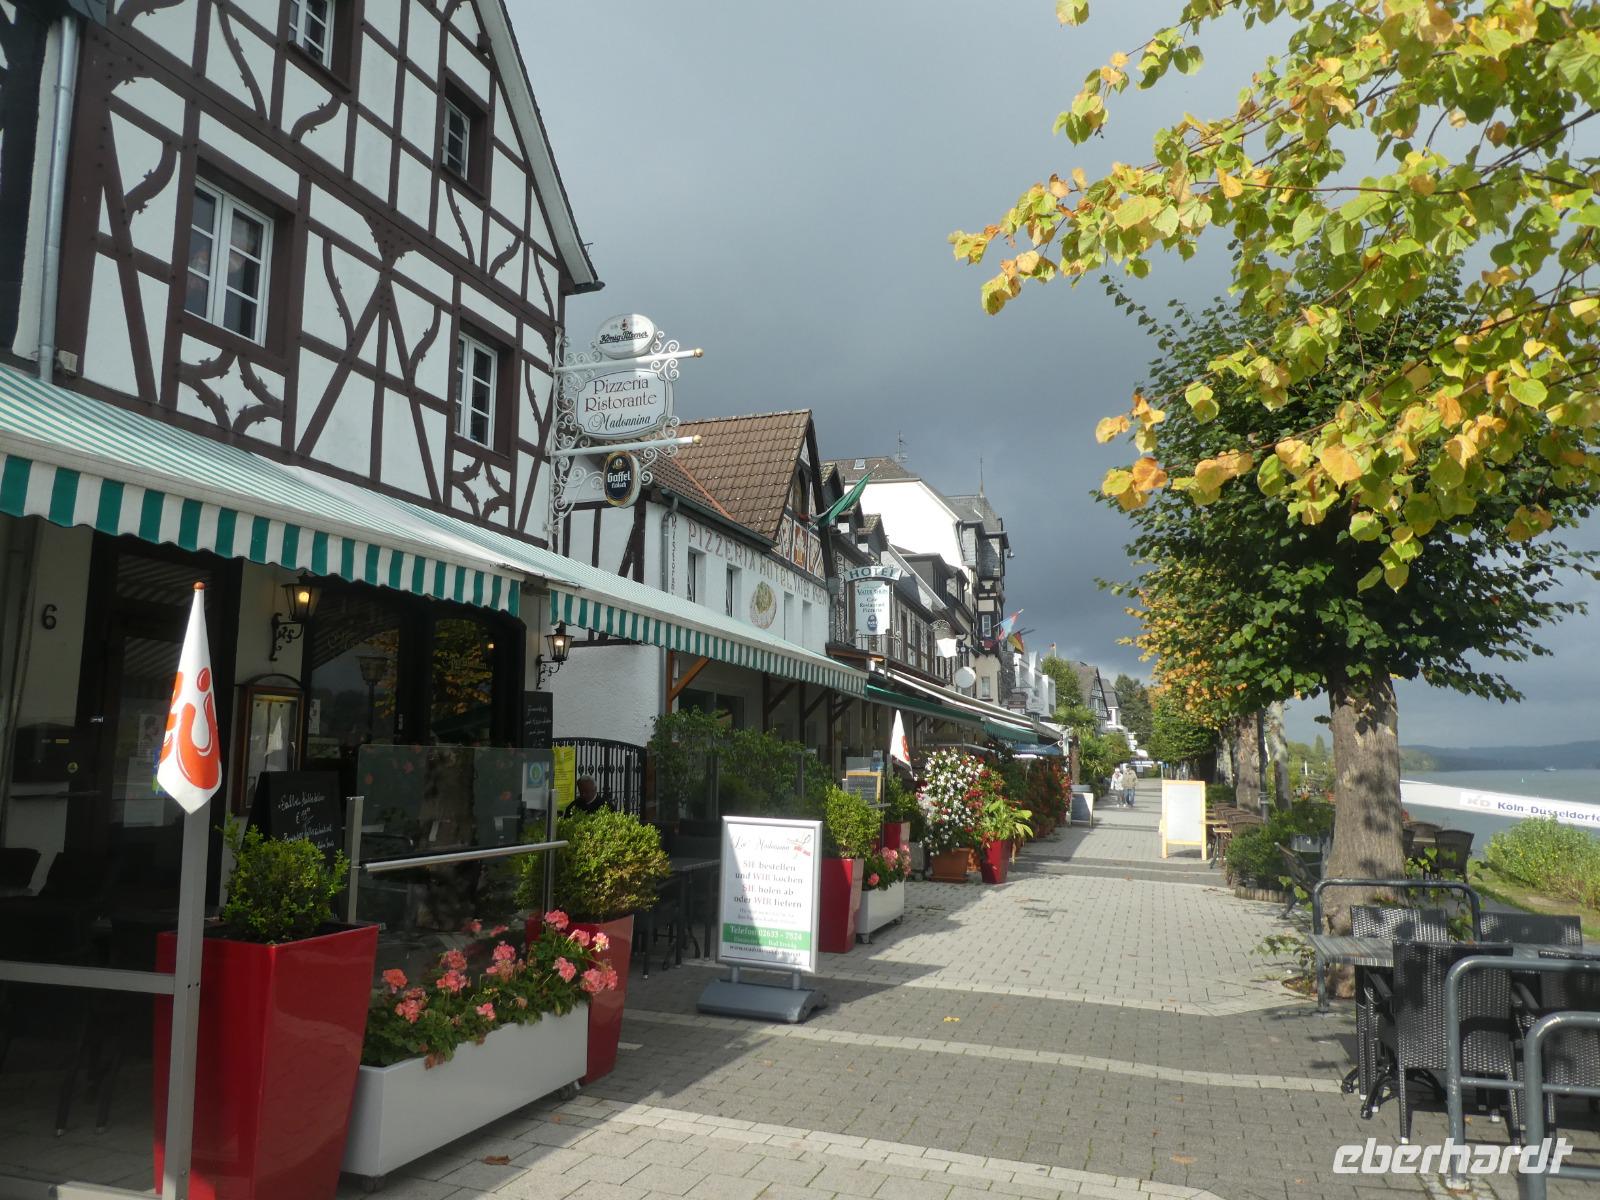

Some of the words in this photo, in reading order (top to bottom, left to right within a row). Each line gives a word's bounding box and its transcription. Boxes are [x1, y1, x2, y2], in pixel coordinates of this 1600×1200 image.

[594, 375, 649, 394] Pizzeria
[584, 392, 657, 412] Ristorante
[588, 411, 651, 431] Madonnina
[607, 470, 632, 482] Gaffel
[687, 518, 756, 572] PIZZERIA
[849, 567, 895, 579] HOTEL
[42, 604, 57, 630] 6
[760, 860, 796, 872] bestellen
[736, 872, 750, 880] und
[784, 888, 794, 896] ab
[734, 896, 750, 904] oder
[730, 925, 757, 936] Telefon
